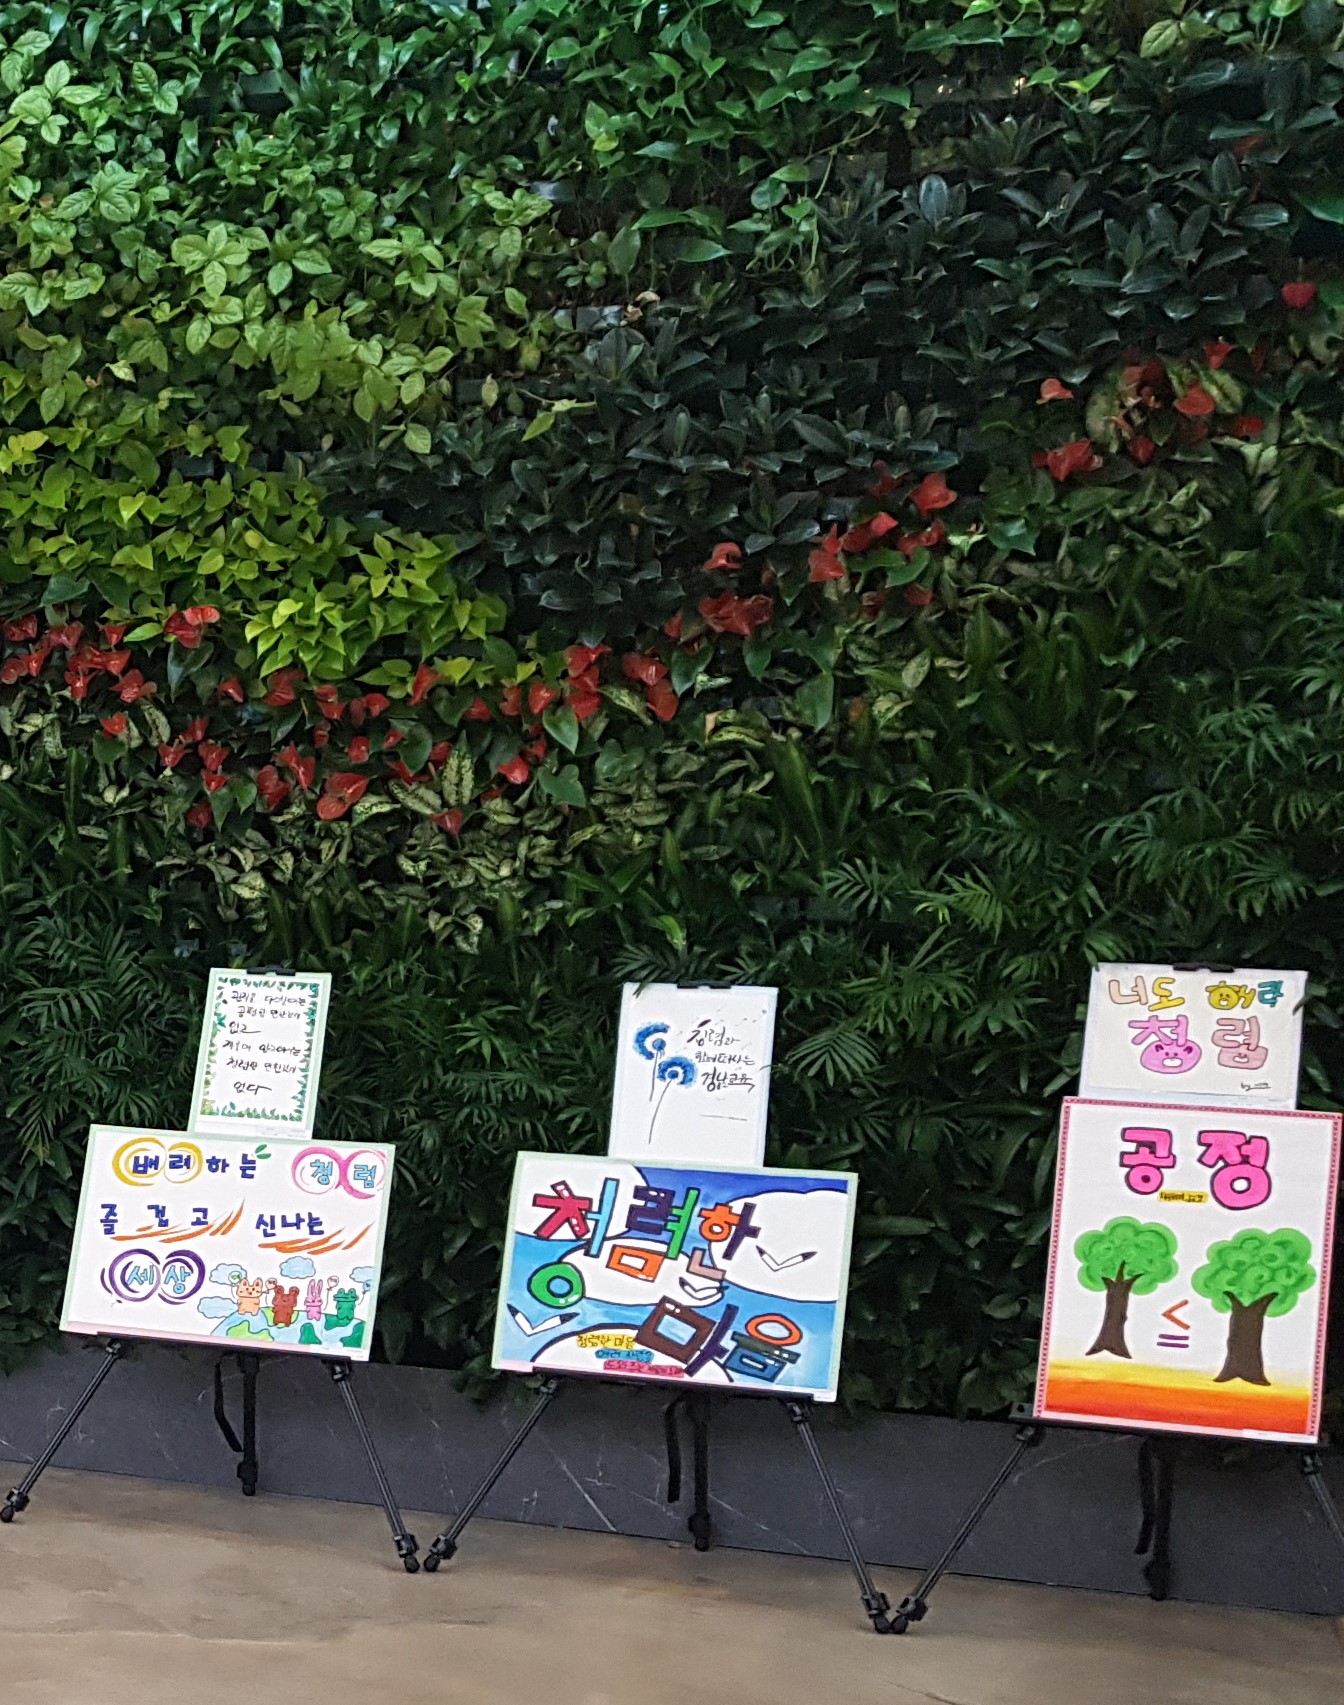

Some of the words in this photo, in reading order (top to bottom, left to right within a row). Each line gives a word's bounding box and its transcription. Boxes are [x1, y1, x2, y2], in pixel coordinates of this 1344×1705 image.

[1108, 975, 1185, 1012] 너도
[1128, 1014, 1269, 1075] 청렴
[132, 1153, 257, 1179] 배려하는
[1119, 1126, 1272, 1211] 공정
[255, 1211, 325, 1238] 신나는
[527, 1177, 762, 1309] 청렴한
[126, 1263, 194, 1295] 세상
[634, 1295, 803, 1382] 마음
